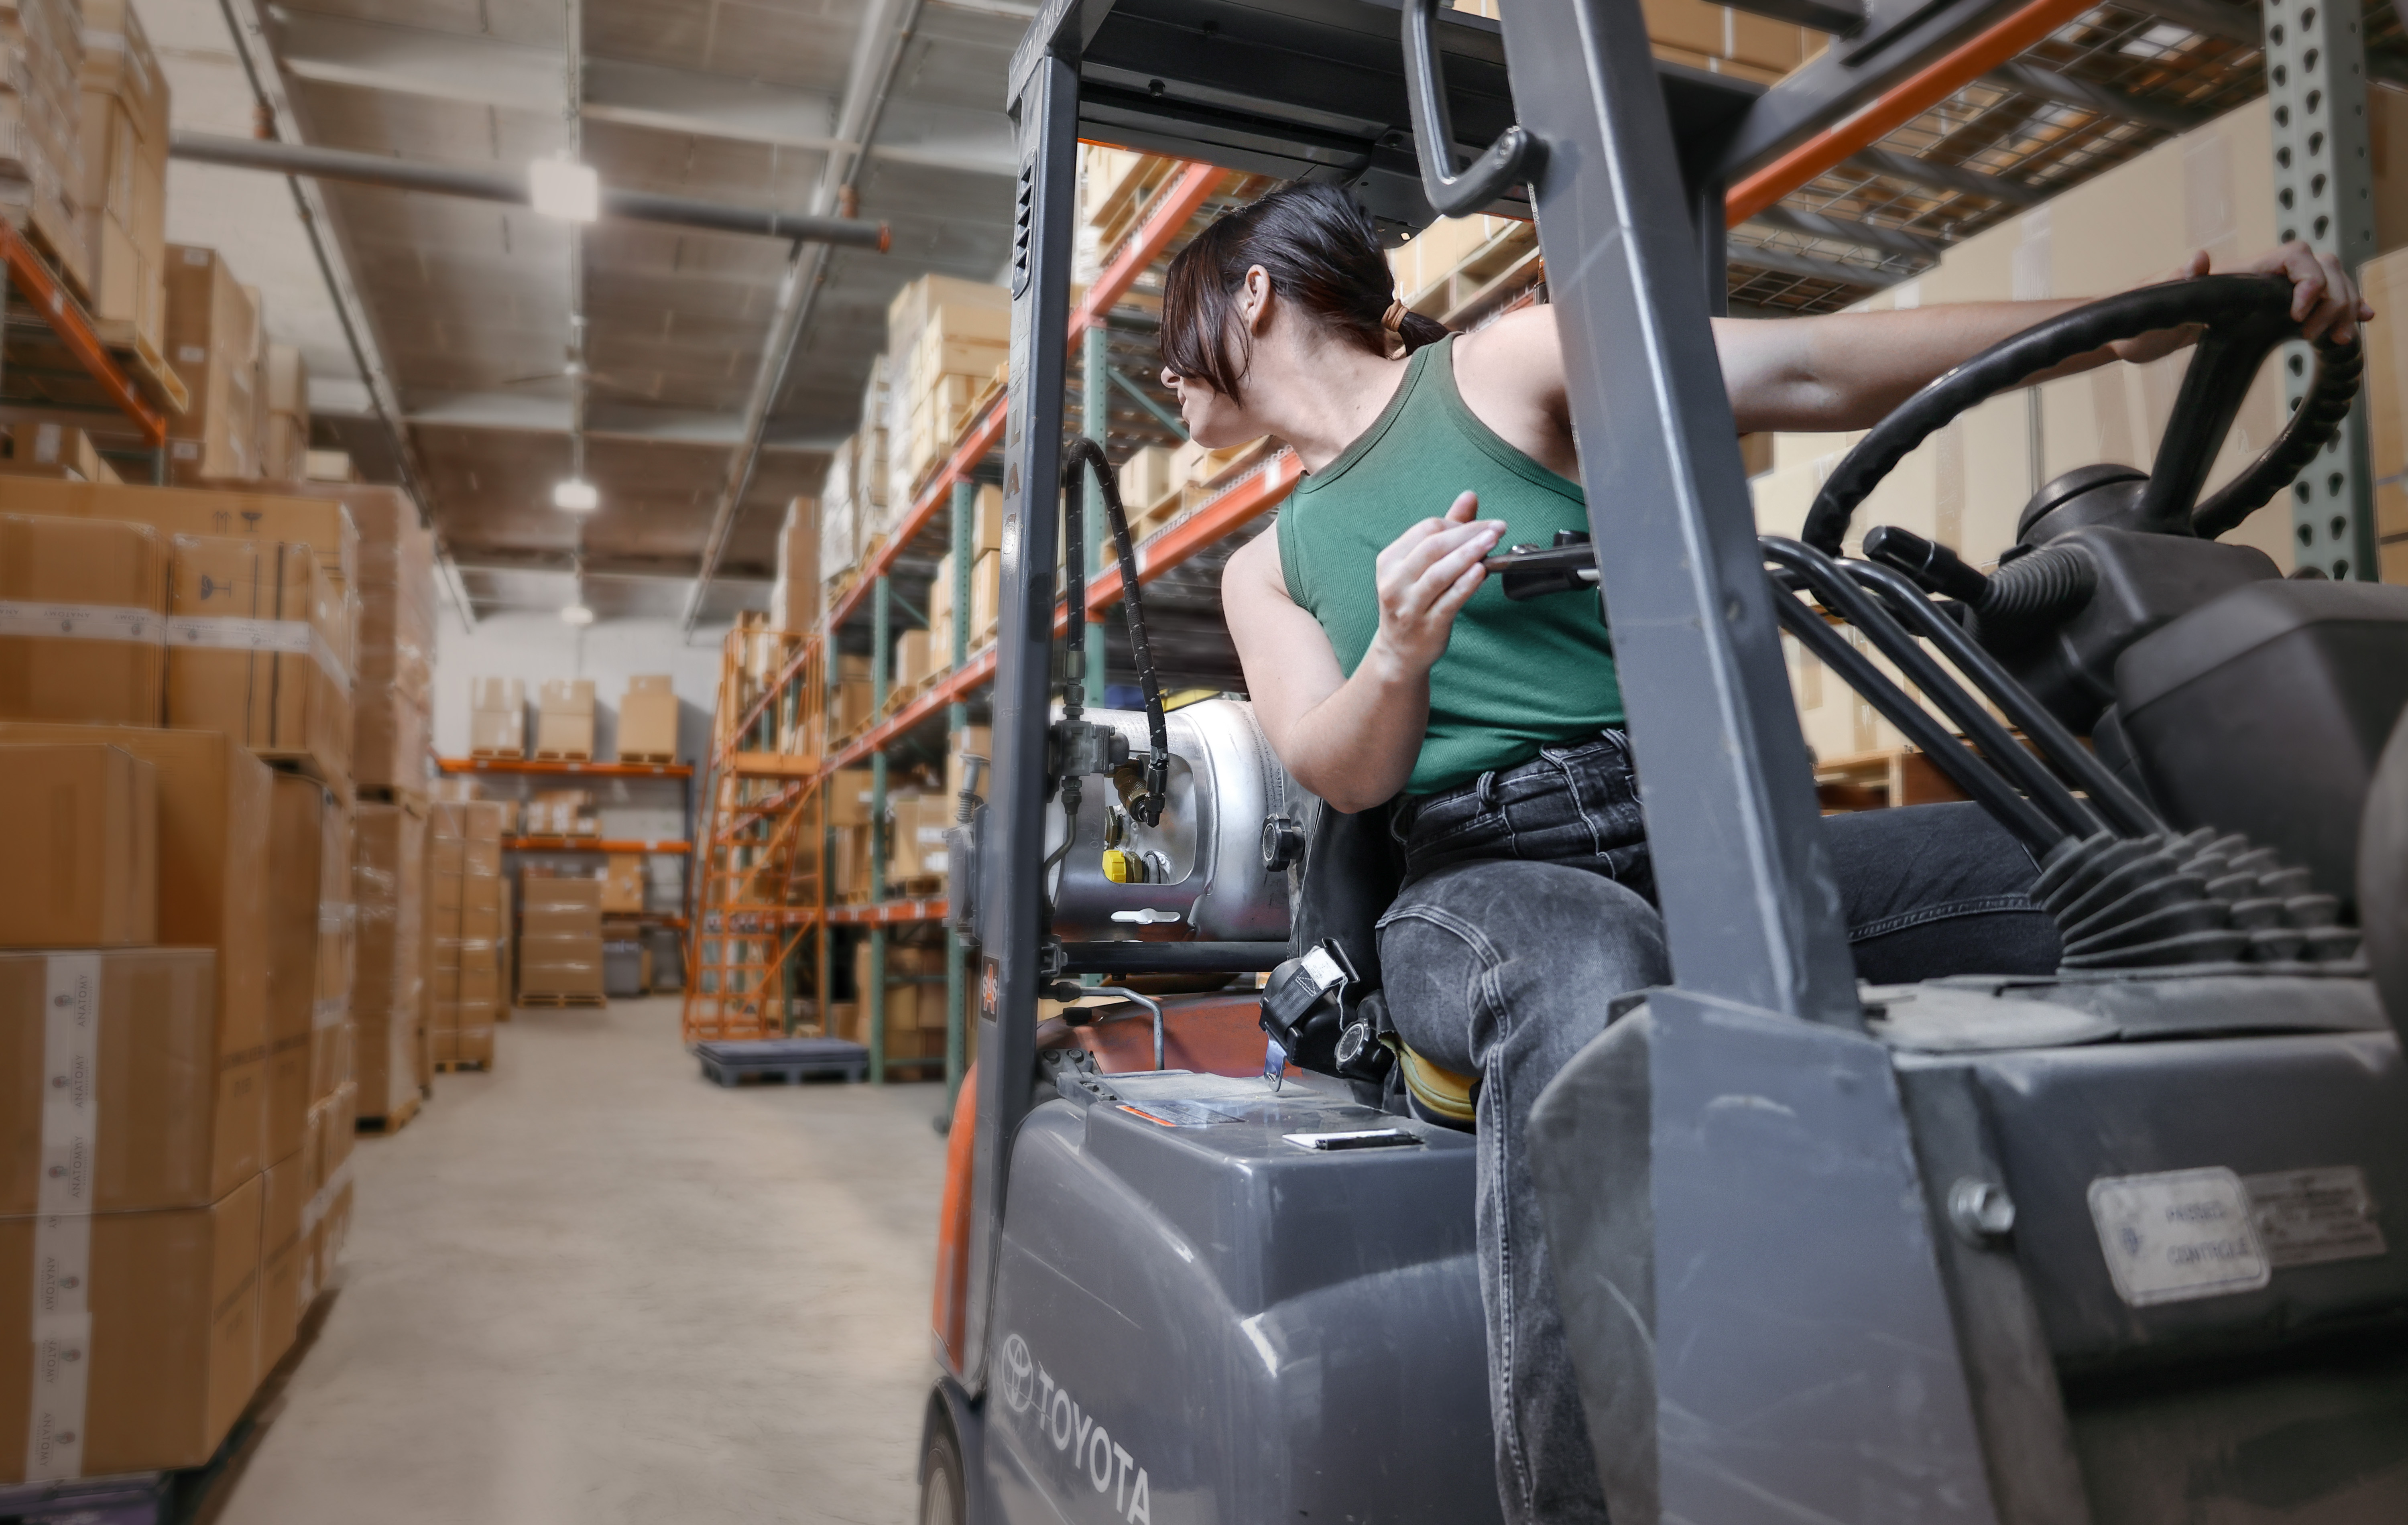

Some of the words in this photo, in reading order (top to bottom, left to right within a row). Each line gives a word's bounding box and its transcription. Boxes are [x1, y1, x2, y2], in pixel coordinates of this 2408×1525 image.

[77, 974, 87, 1027] ANATOMY
[982, 964, 997, 1015] GAS
[75, 1055, 84, 1108] ANATOMY
[46, 1257, 55, 1311] ANATOMY
[40, 1412, 51, 1467] ANATOMY
[1039, 1370, 1151, 1525] TOYOTA
